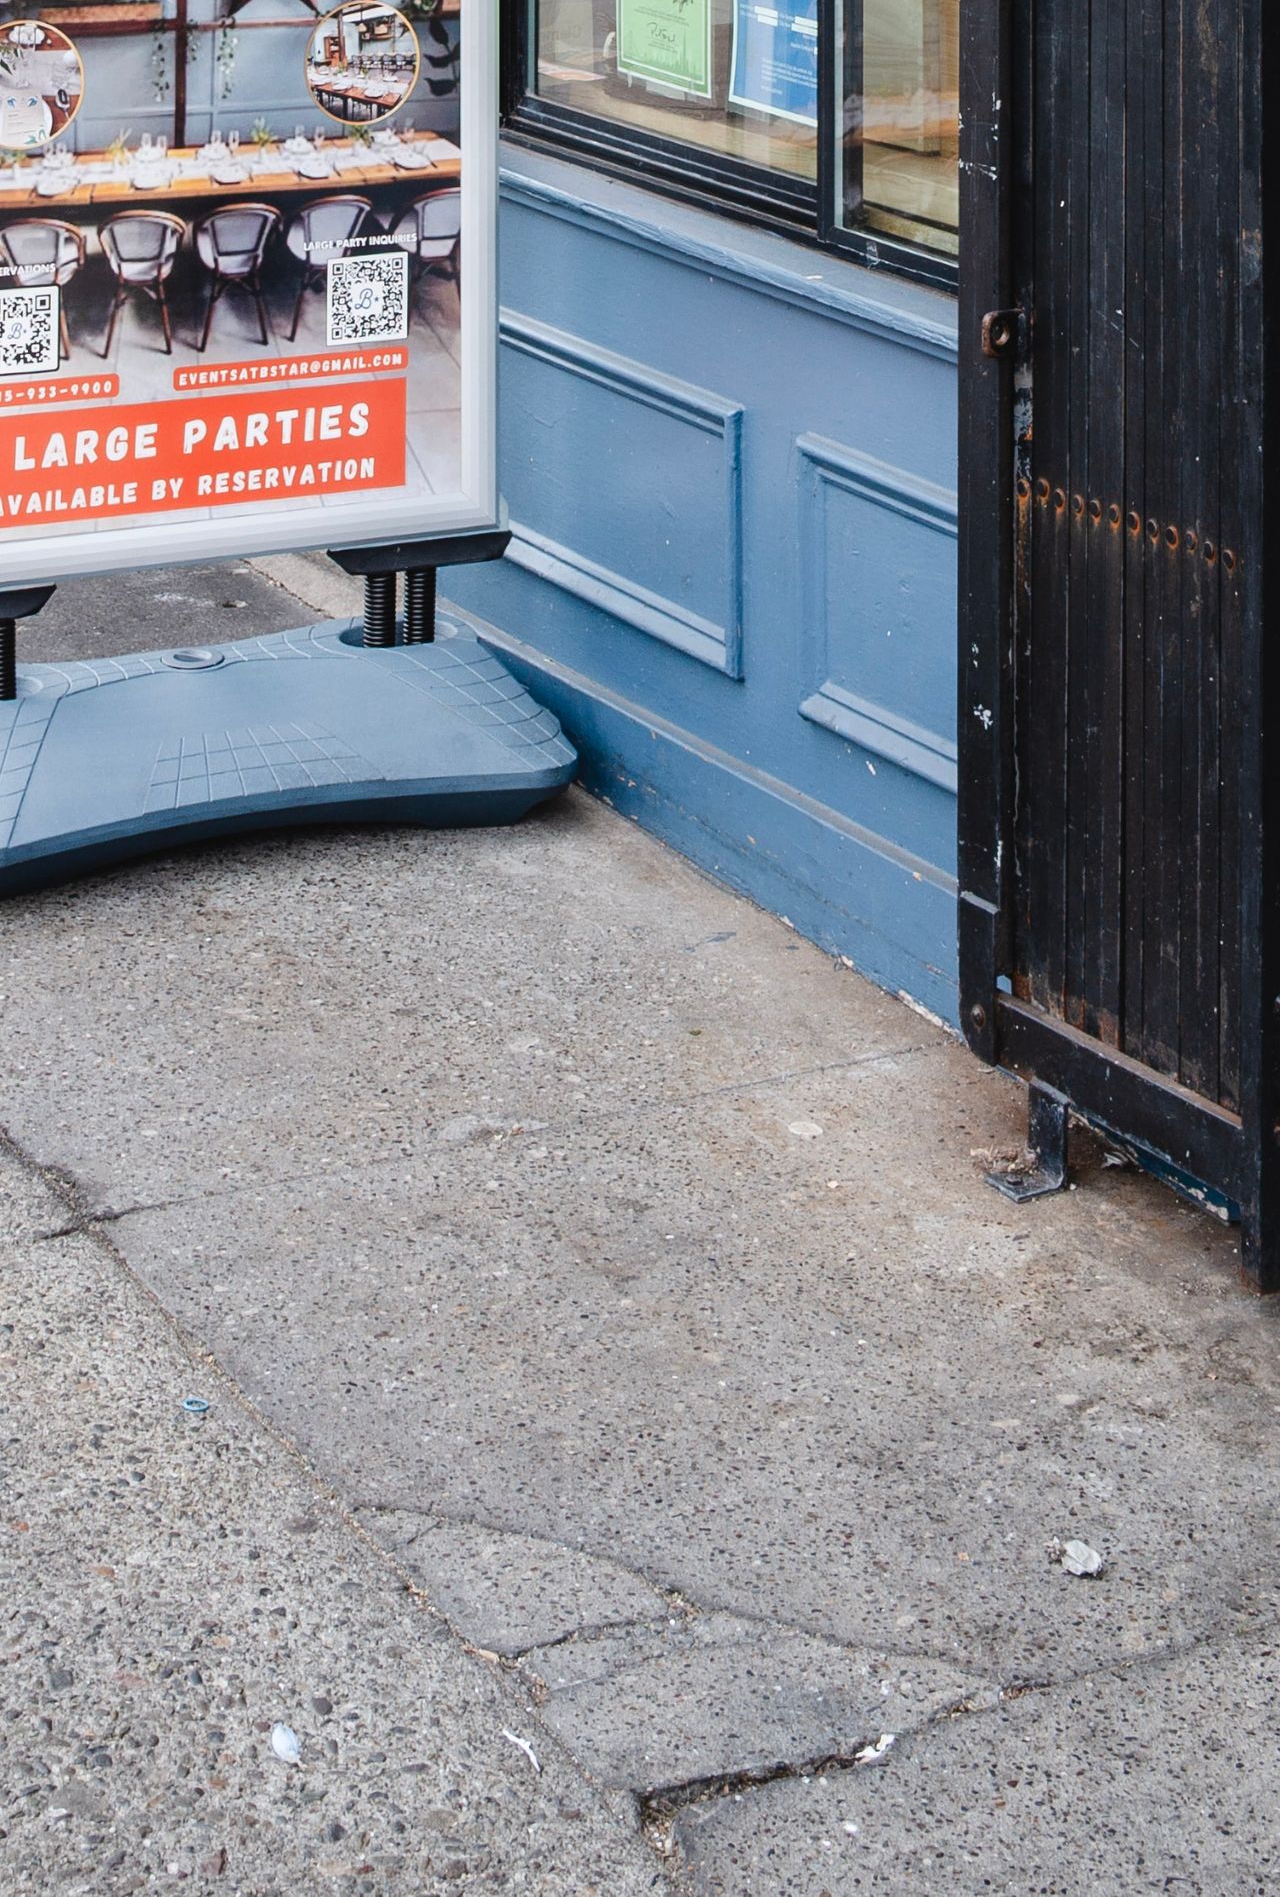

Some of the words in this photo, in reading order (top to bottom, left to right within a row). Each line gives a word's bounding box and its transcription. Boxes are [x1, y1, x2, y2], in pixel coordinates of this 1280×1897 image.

[303, 240, 334, 251] LARGE
[336, 236, 367, 247] PARTY
[369, 233, 417, 246] INQUIRIES
[178, 353, 403, 387] EVENTSATBSTAR@GMAIL.COM
[14, 423, 158, 471] LARGE
[183, 402, 369, 455] PARTIES
[151, 477, 184, 501] BY
[197, 457, 376, 496] RESERVATION
